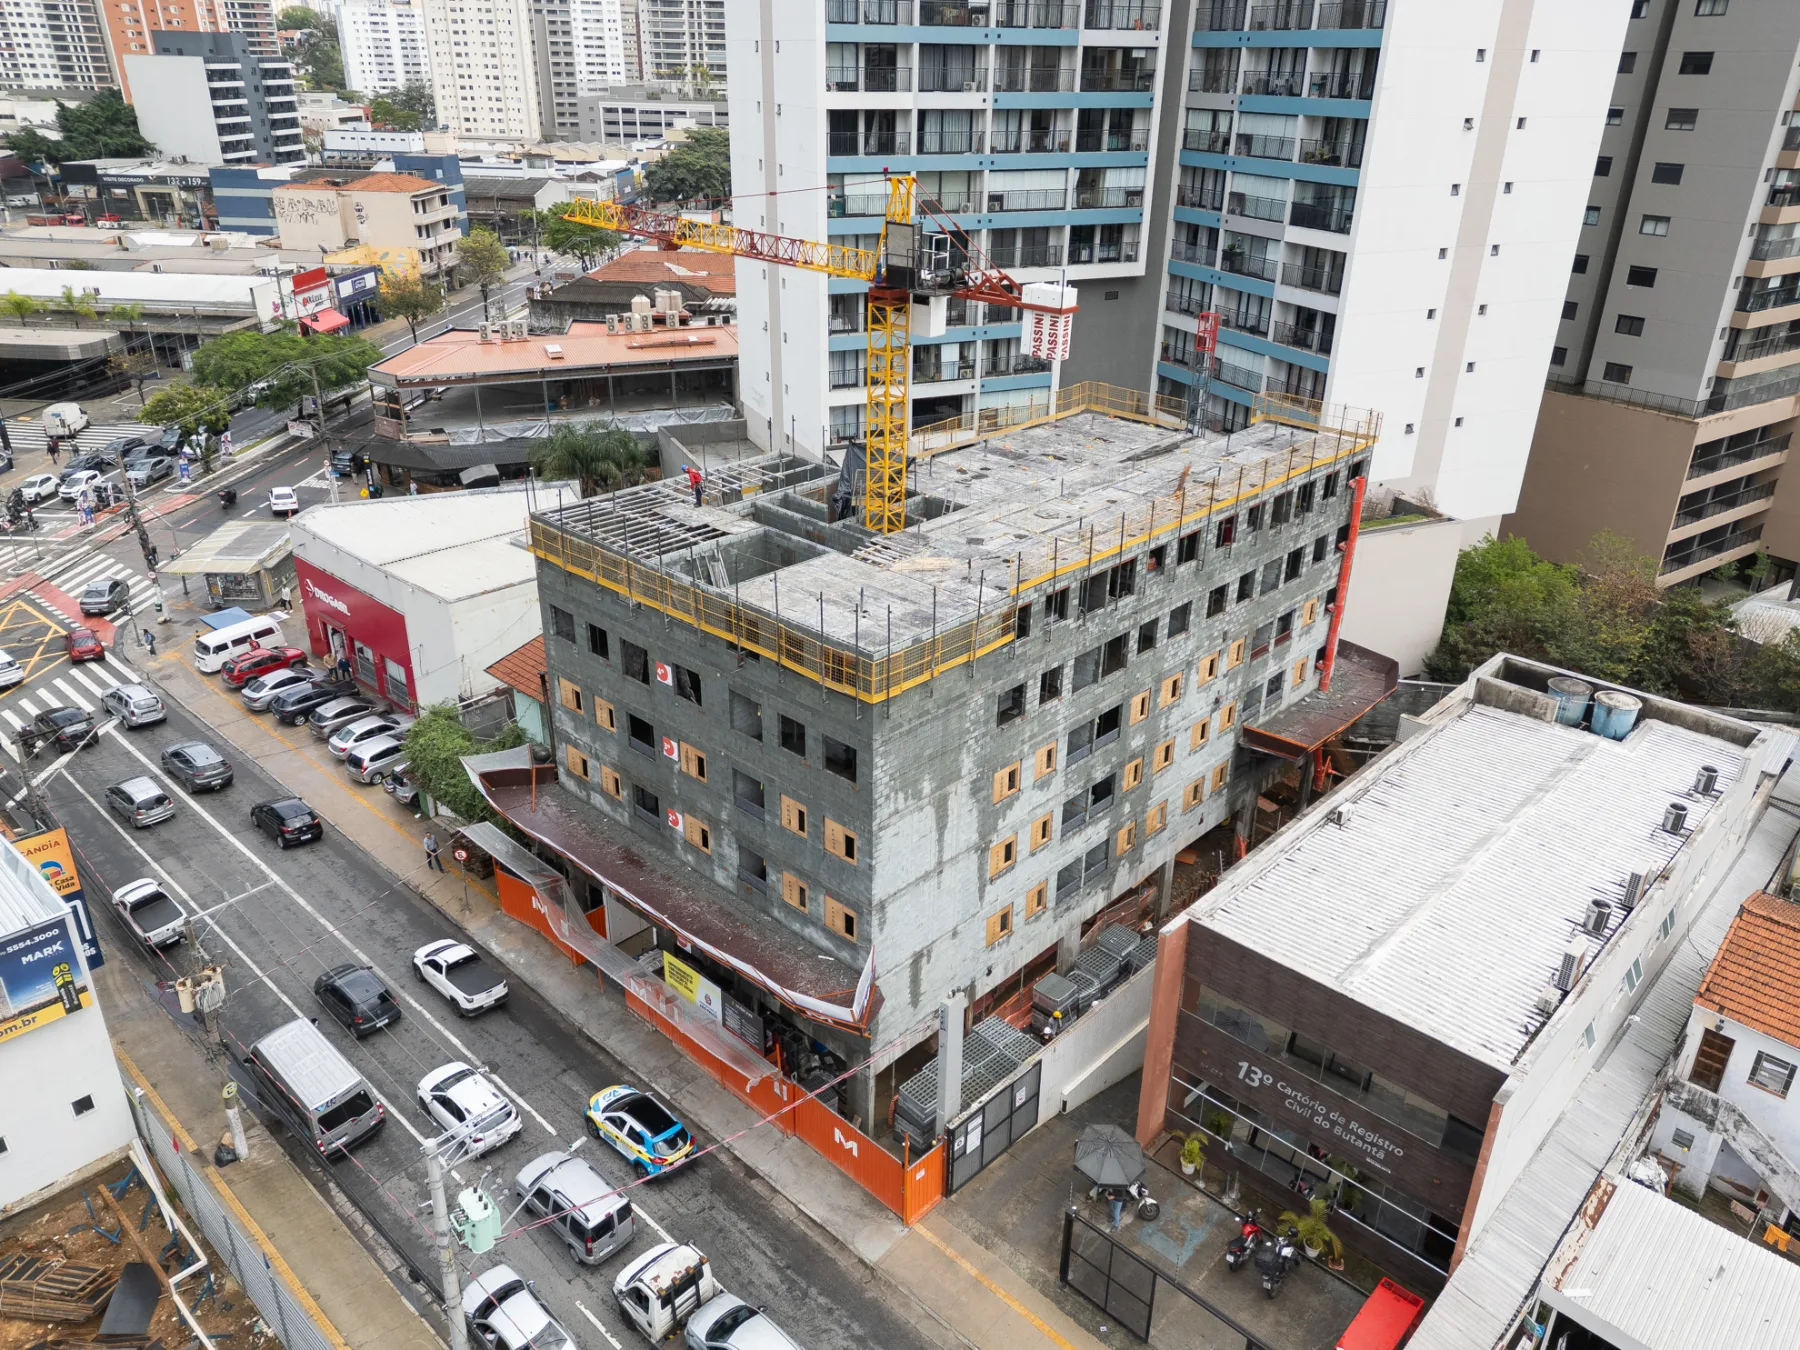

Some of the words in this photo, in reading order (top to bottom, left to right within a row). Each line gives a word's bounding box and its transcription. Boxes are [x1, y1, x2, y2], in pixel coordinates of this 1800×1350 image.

[188, 177, 202, 186] 159
[1032, 313, 1045, 359] PASSINI
[1046, 315, 1060, 361] PASSINI
[1060, 315, 1071, 360] PASSINI
[314, 586, 351, 617] DROGASIL
[54, 875, 75, 886] Casa
[55, 881, 76, 892] Vida
[6, 928, 60, 954] 5554.3000
[21, 940, 65, 965] MARK
[1237, 1061, 1273, 1087] 13º
[1276, 1081, 1327, 1115] Cartório
[1329, 1111, 1347, 1125] de
[1349, 1120, 1404, 1157] Registro
[1284, 1099, 1312, 1119] Civil
[1313, 1115, 1330, 1130] do
[1333, 1125, 1386, 1160] Butantã
